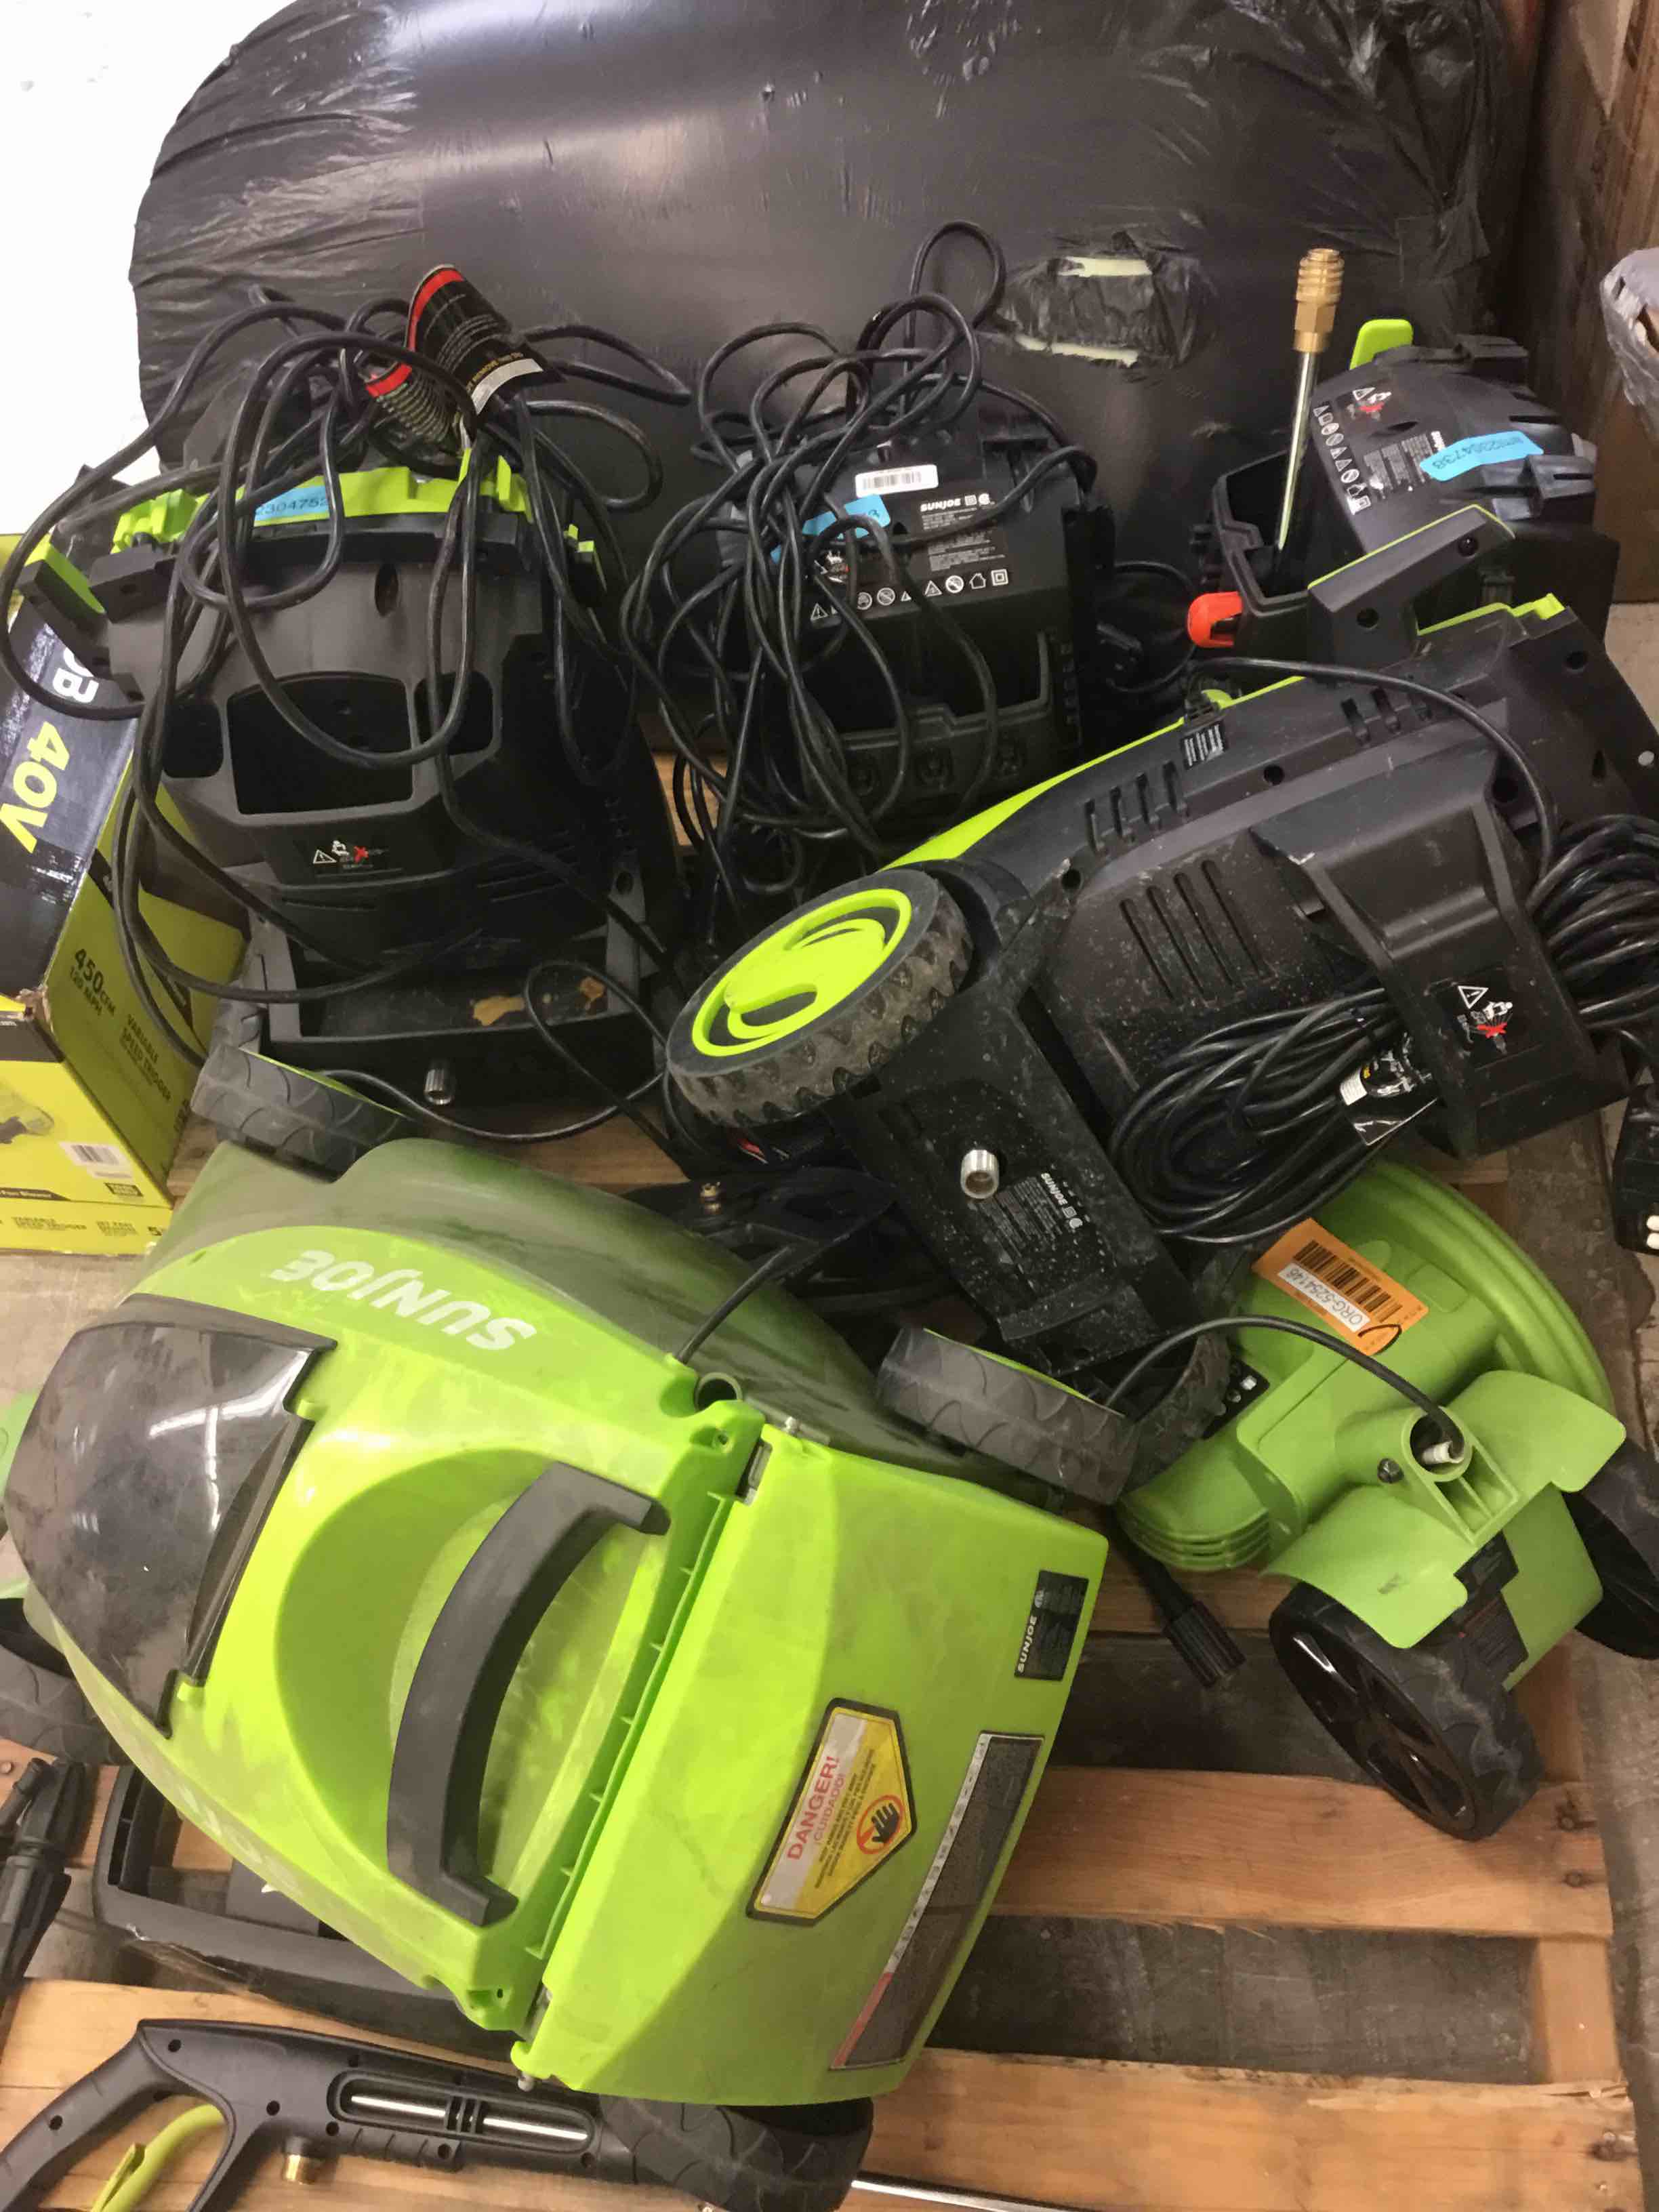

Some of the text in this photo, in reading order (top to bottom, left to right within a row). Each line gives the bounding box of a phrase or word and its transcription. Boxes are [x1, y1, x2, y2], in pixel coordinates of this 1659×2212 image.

[920, 497, 962, 512] SUNJOE
[0, 721, 70, 854] 40V
[1041, 1172, 1068, 1206] SUNJOE
[269, 1250, 537, 1351] SUNJOE
[1017, 1615, 1037, 1673] SUNJOE
[787, 1756, 841, 1860] DANGER!
